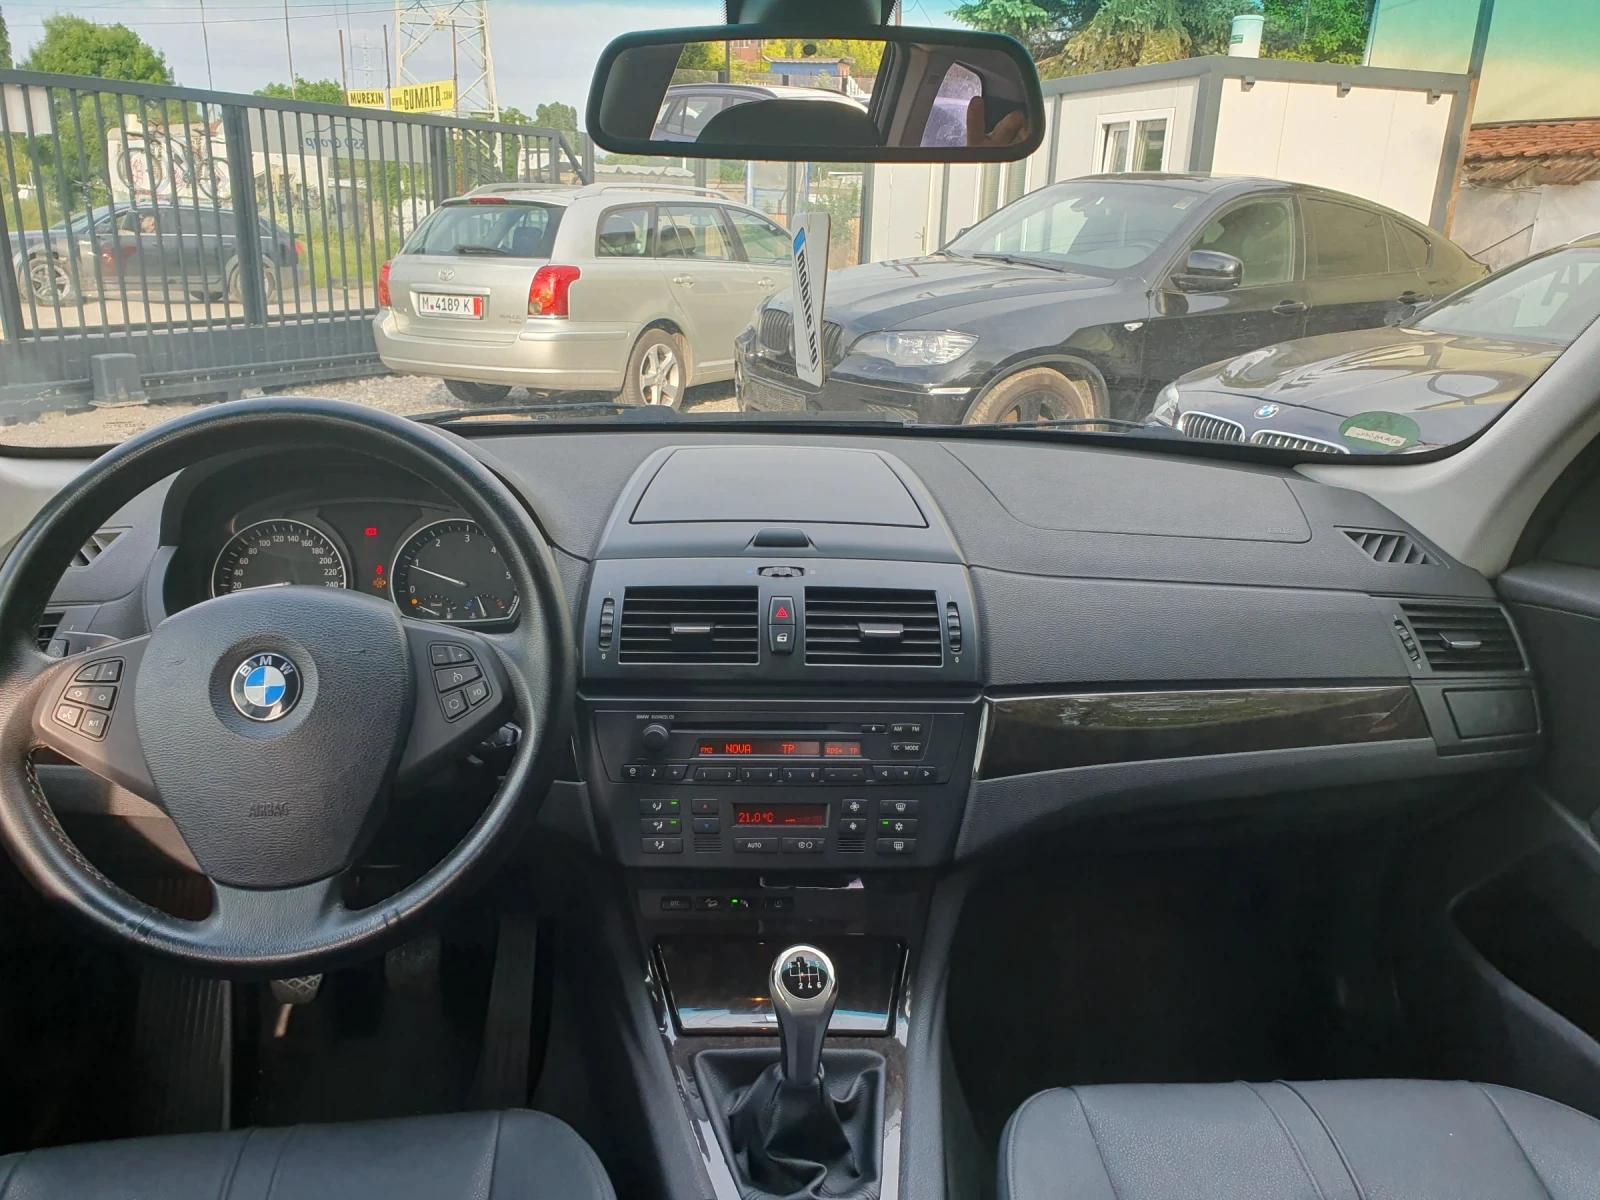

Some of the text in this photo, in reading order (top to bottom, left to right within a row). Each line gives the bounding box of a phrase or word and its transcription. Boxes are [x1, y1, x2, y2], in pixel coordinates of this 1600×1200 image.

[350, 92, 384, 104] MUREXIN
[435, 298, 460, 311] 4189
[797, 249, 818, 365] mobile.bg
[435, 538, 441, 547] 2
[248, 547, 258, 555] 80
[312, 547, 324, 555] 180
[491, 546, 497, 554] 4
[239, 557, 249, 565] 60
[319, 557, 332, 565] 200
[415, 559, 419, 567] 1
[234, 568, 244, 576] 40
[324, 568, 337, 576] 220
[506, 571, 512, 580] 5
[410, 585, 416, 594] 0
[239, 655, 294, 677] BMW
[725, 743, 751, 754] NOVA
[781, 744, 795, 754] TP
[850, 747, 858, 755] TP
